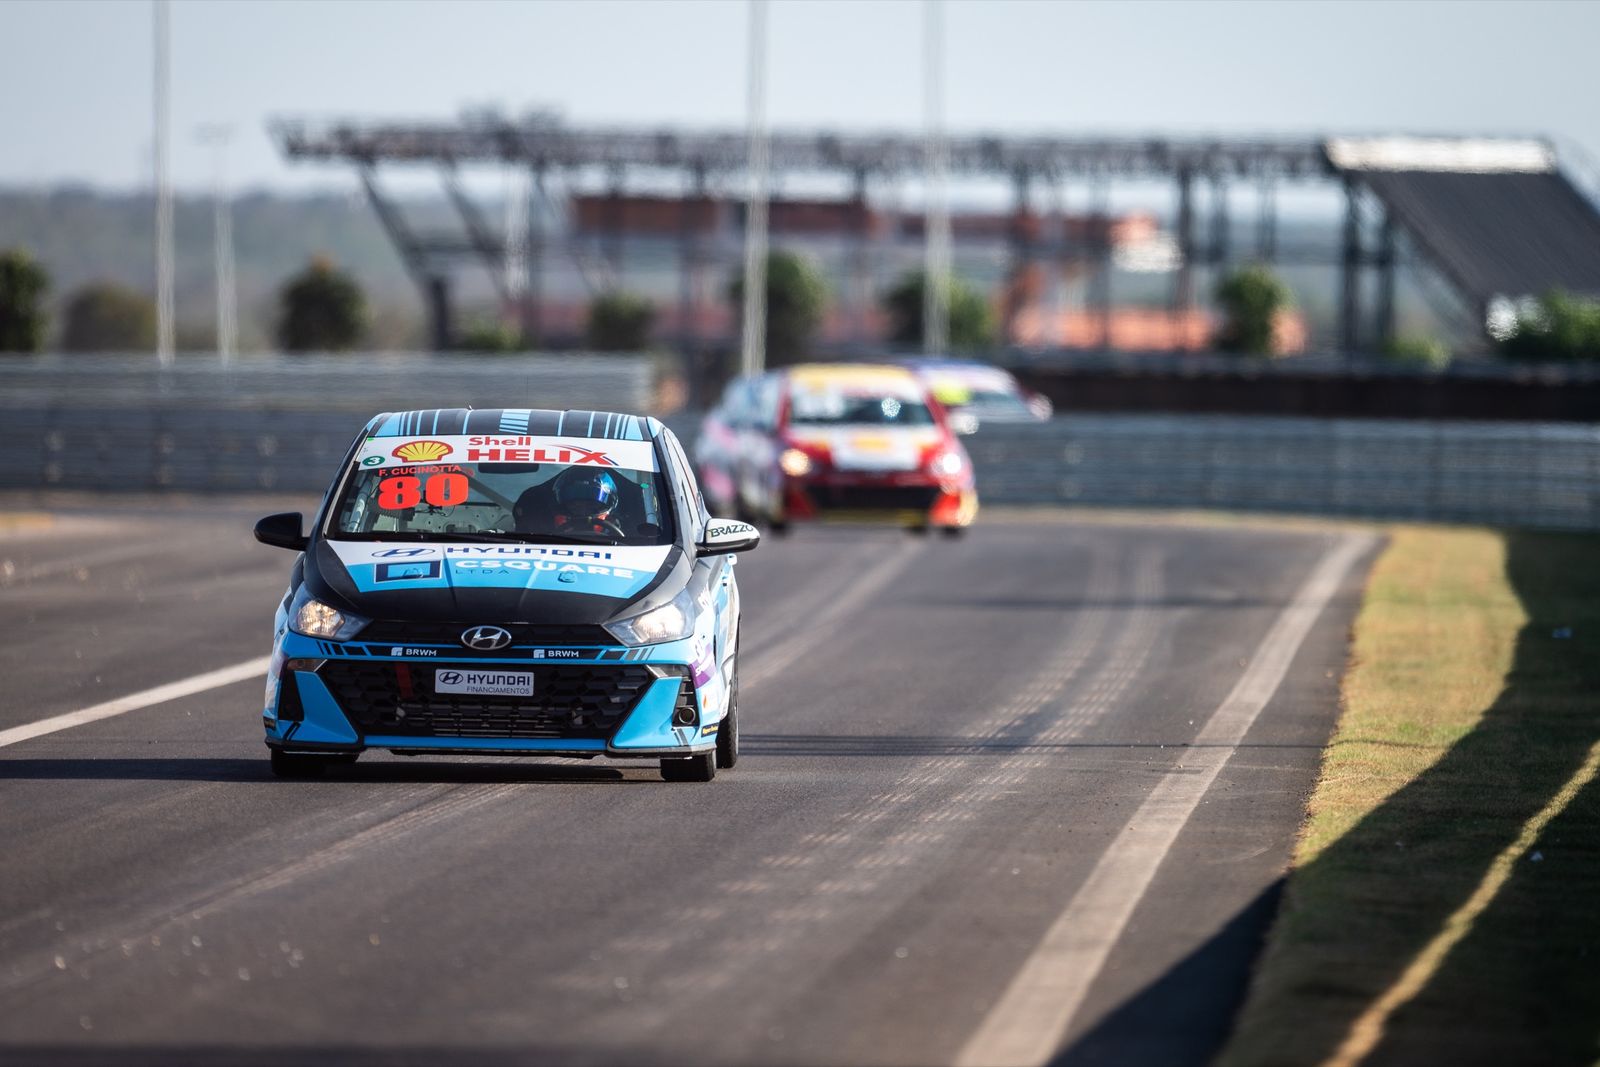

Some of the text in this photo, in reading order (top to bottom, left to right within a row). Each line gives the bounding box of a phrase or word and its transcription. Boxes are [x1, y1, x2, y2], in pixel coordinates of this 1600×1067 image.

[468, 436, 531, 446] Shell
[367, 457, 380, 465] 3
[467, 448, 613, 466] HELIX
[391, 465, 461, 475] CUCINOTTA
[378, 473, 469, 510] 80
[447, 548, 612, 559] HYUNDAI
[455, 560, 634, 578] CSQUARE
[406, 648, 437, 657] BRWM
[548, 650, 579, 658] BRWM
[467, 674, 530, 686] HYUNDAI
[466, 686, 530, 694] FINANCIAMENTOS
